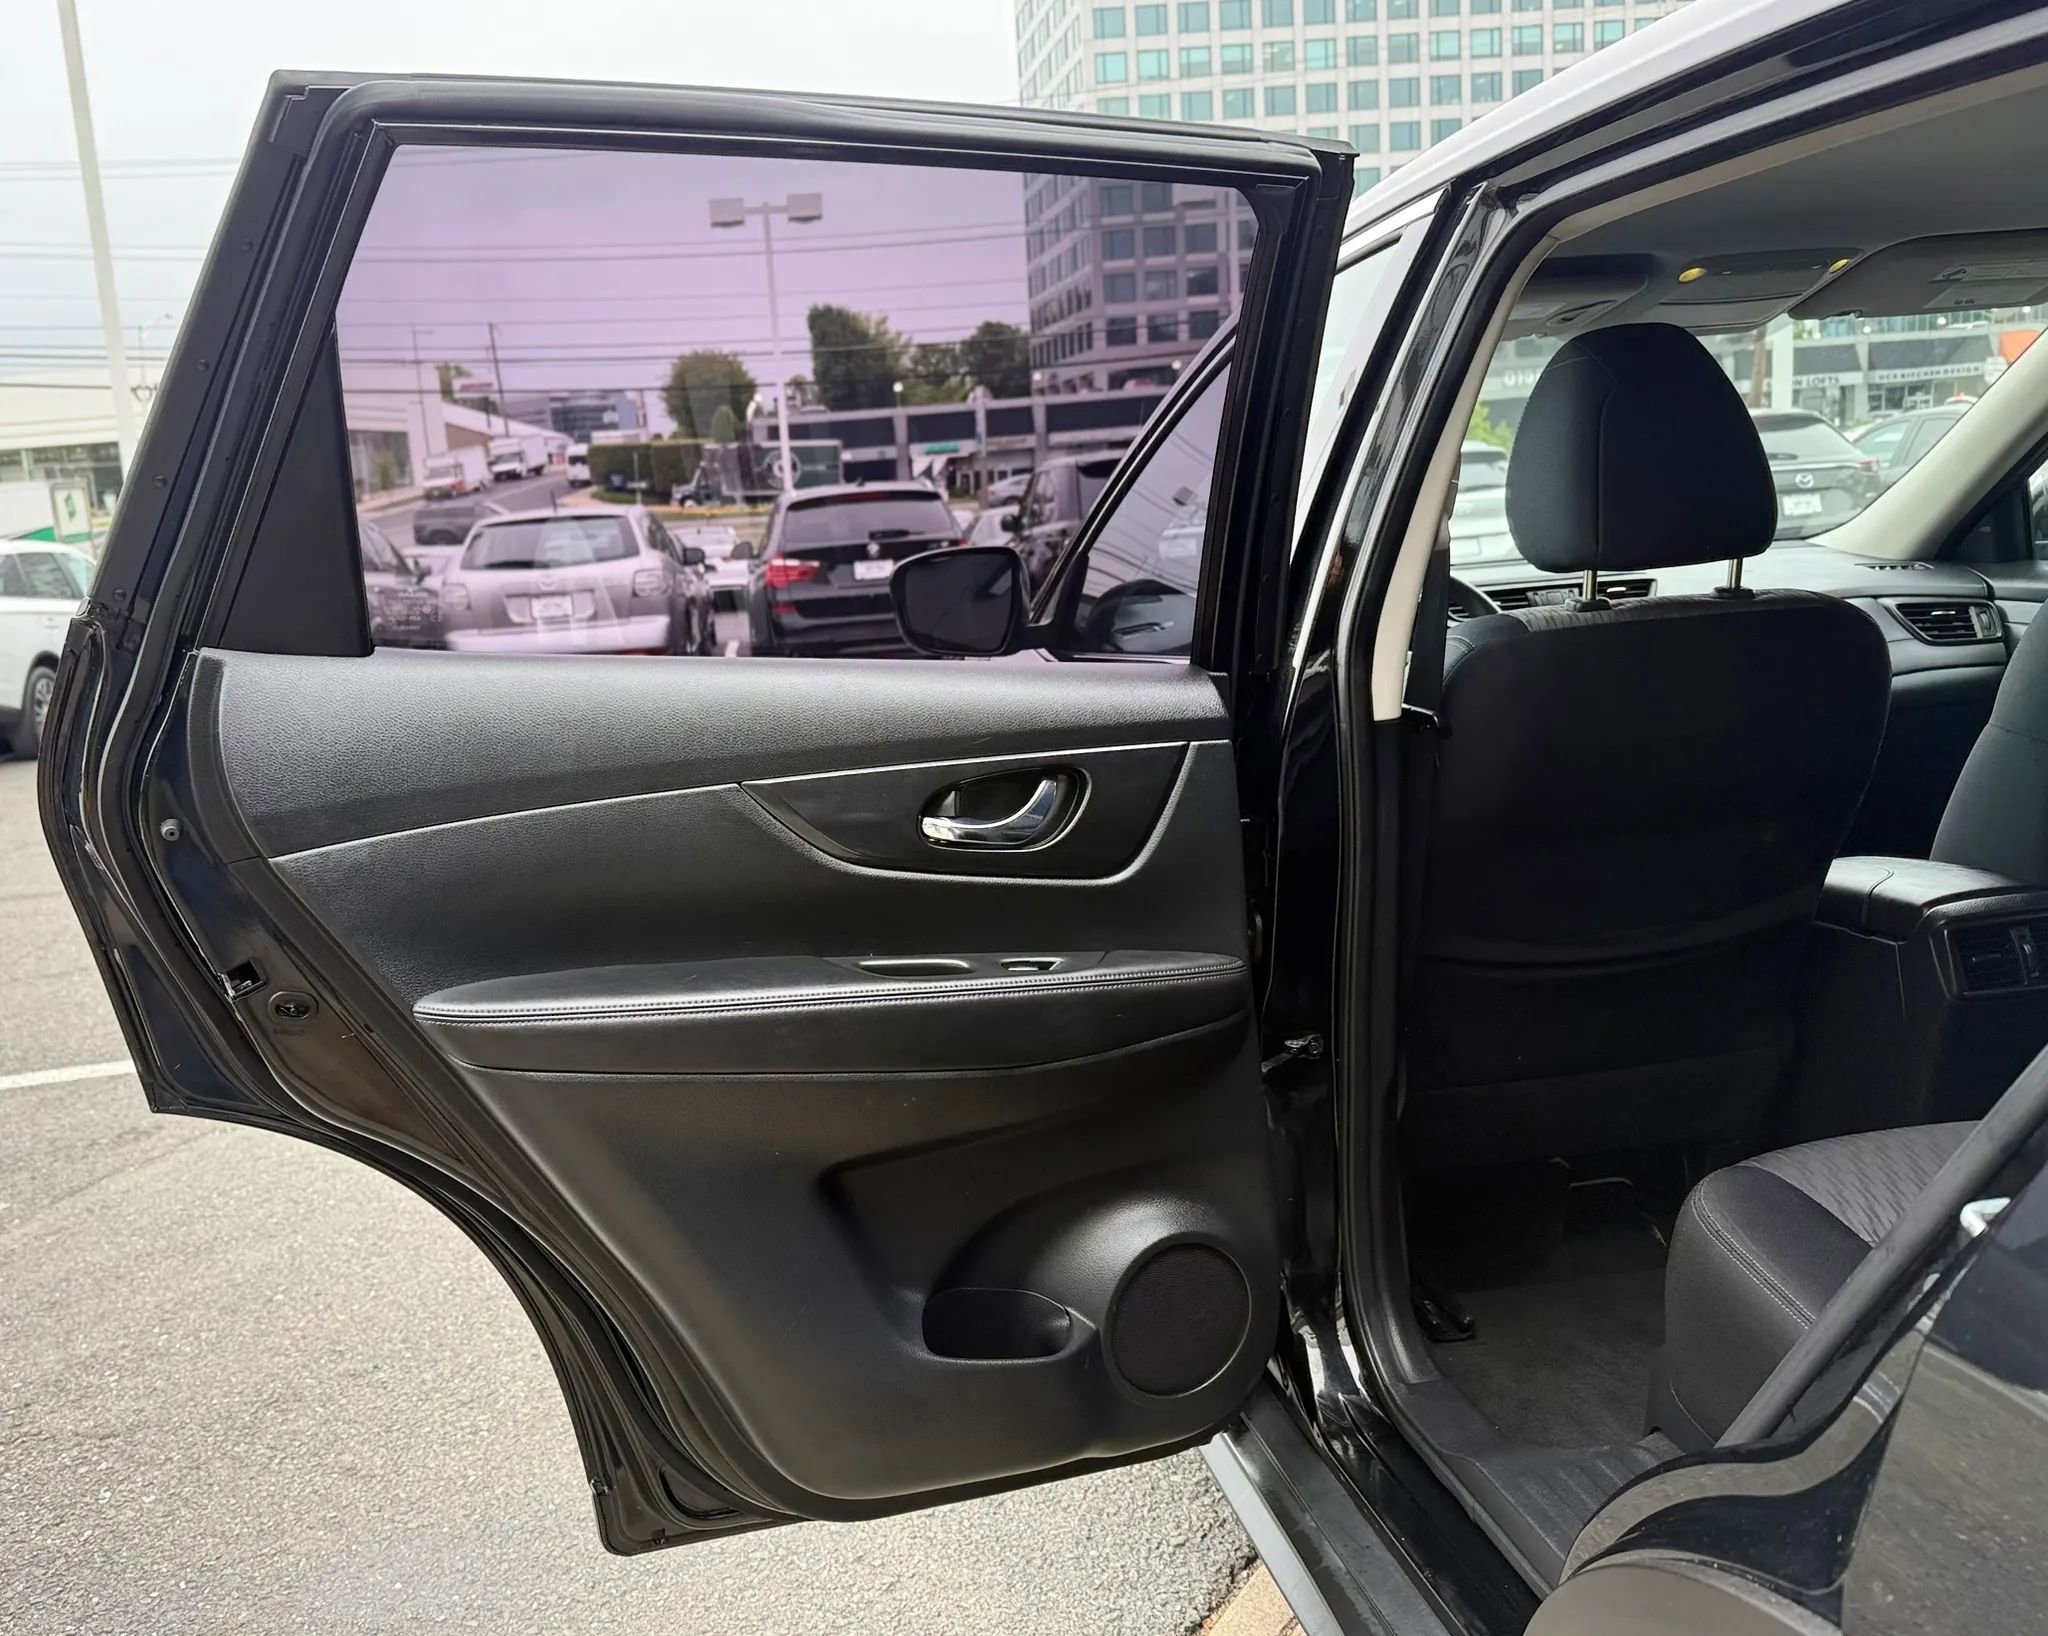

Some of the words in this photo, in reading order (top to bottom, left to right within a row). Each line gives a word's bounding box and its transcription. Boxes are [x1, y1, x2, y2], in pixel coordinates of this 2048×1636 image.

[1900, 369, 1941, 379] KITCHEN
[1943, 366, 1980, 375] DESIGN
[1807, 375, 1839, 387] LOFTS
